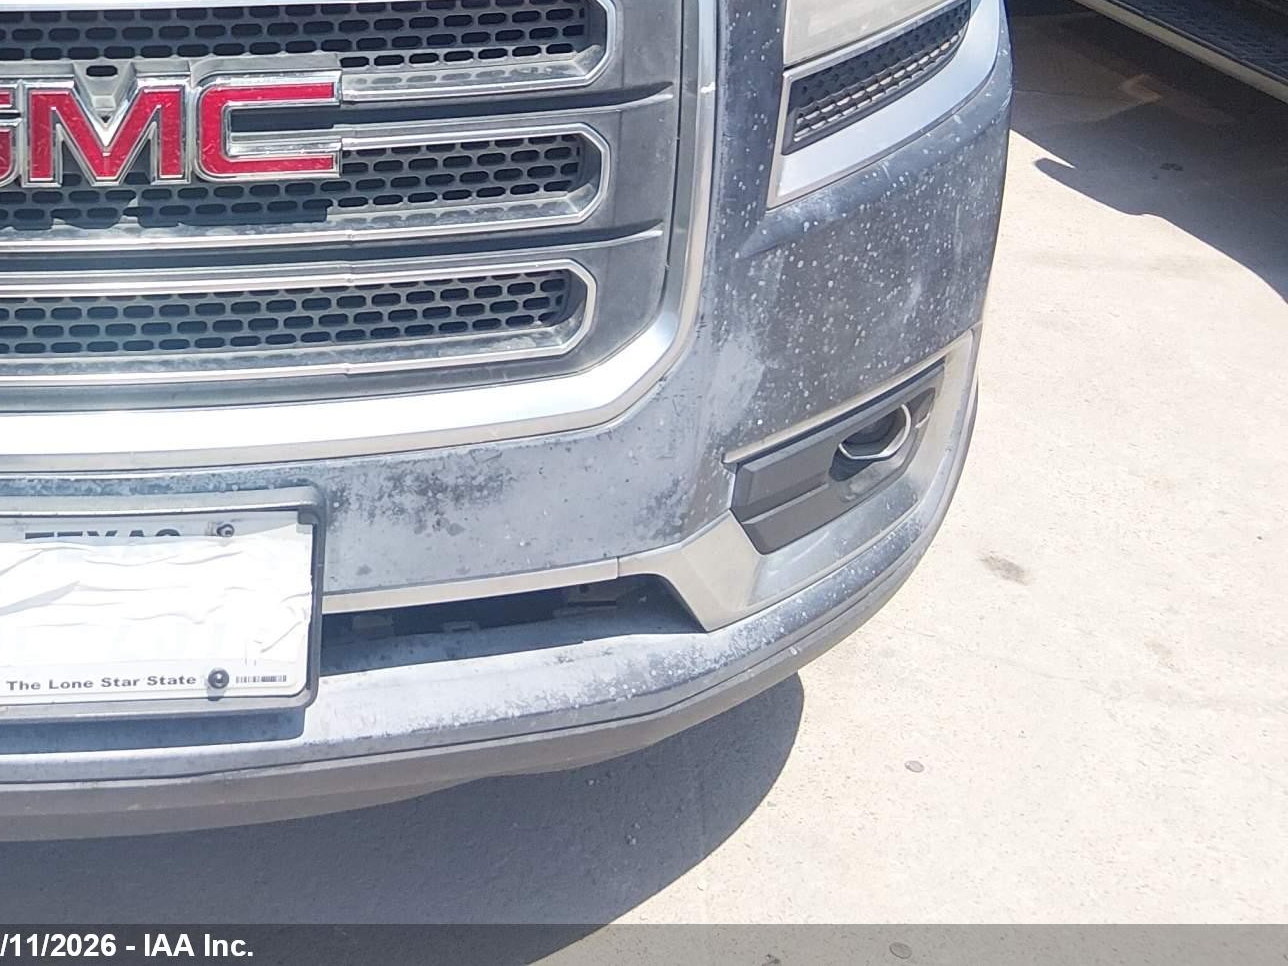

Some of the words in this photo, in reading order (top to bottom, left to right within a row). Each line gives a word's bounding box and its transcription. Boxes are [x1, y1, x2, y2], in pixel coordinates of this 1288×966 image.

[6, 680, 41, 691] The
[48, 679, 94, 690] Lone
[100, 676, 140, 688] Star
[146, 674, 197, 686] State
